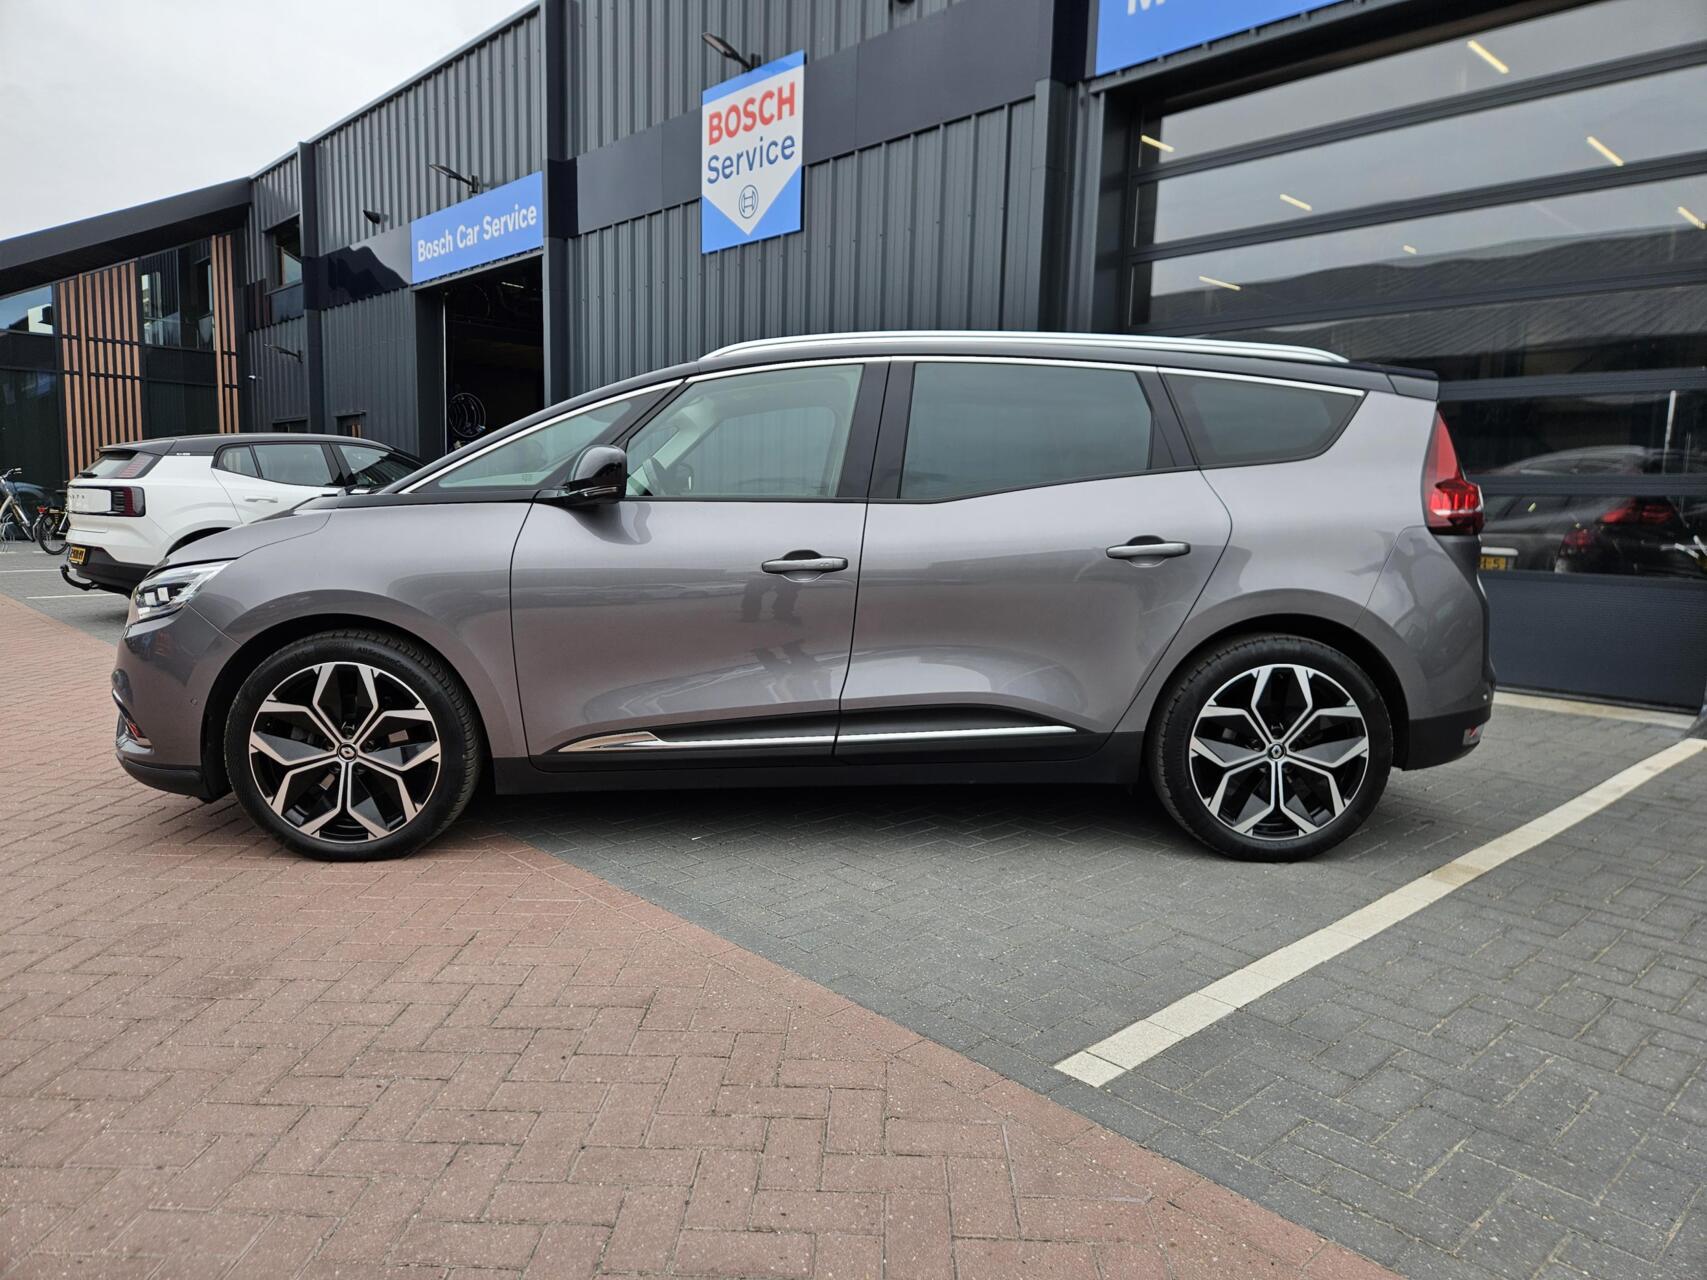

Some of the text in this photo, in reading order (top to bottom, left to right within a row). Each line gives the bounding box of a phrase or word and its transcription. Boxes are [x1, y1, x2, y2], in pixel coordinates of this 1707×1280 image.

[708, 81, 796, 146] BOSCH
[707, 135, 796, 184] Service
[418, 203, 537, 263] Bosch Car Service
